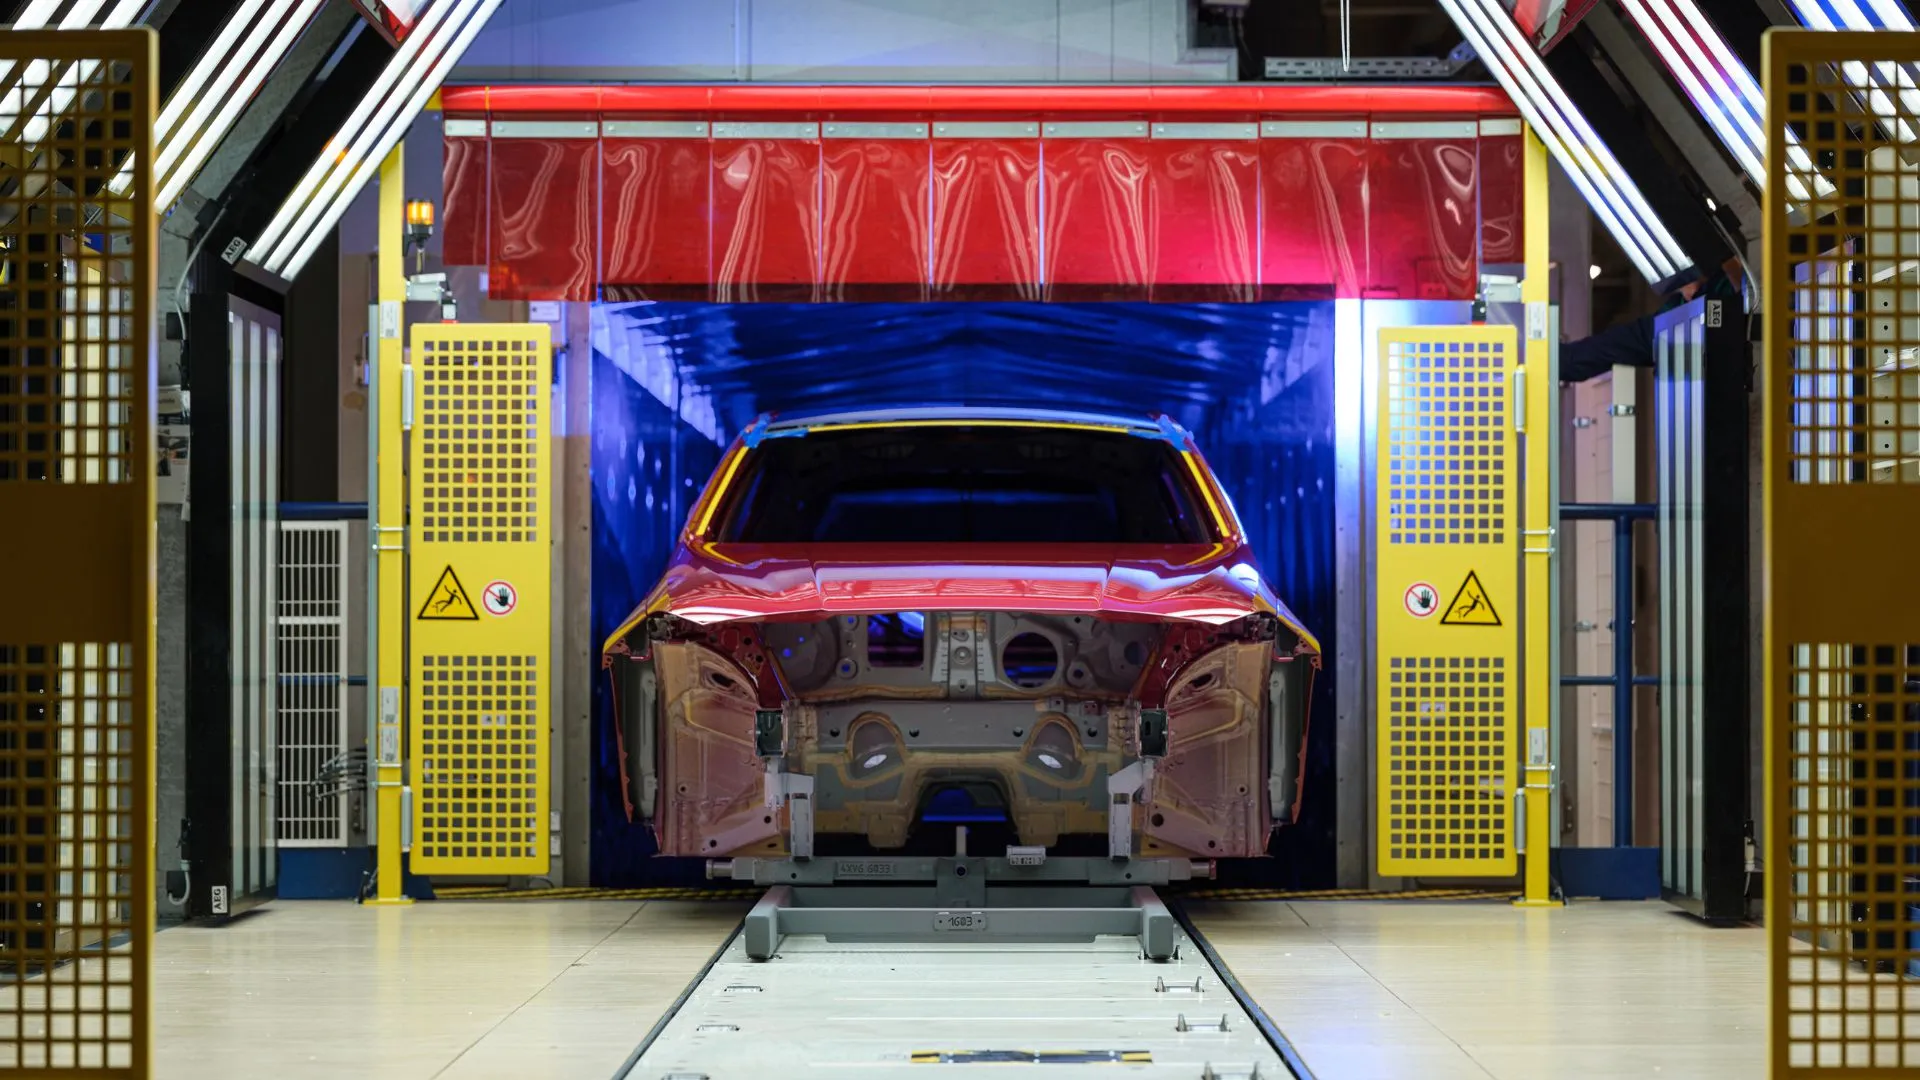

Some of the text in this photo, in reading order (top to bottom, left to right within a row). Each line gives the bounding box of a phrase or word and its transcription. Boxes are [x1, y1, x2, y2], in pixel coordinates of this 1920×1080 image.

[225, 240, 241, 258] AEG
[1713, 303, 1721, 325] AEG
[213, 888, 222, 910] AEG
[948, 916, 973, 927] 1603
